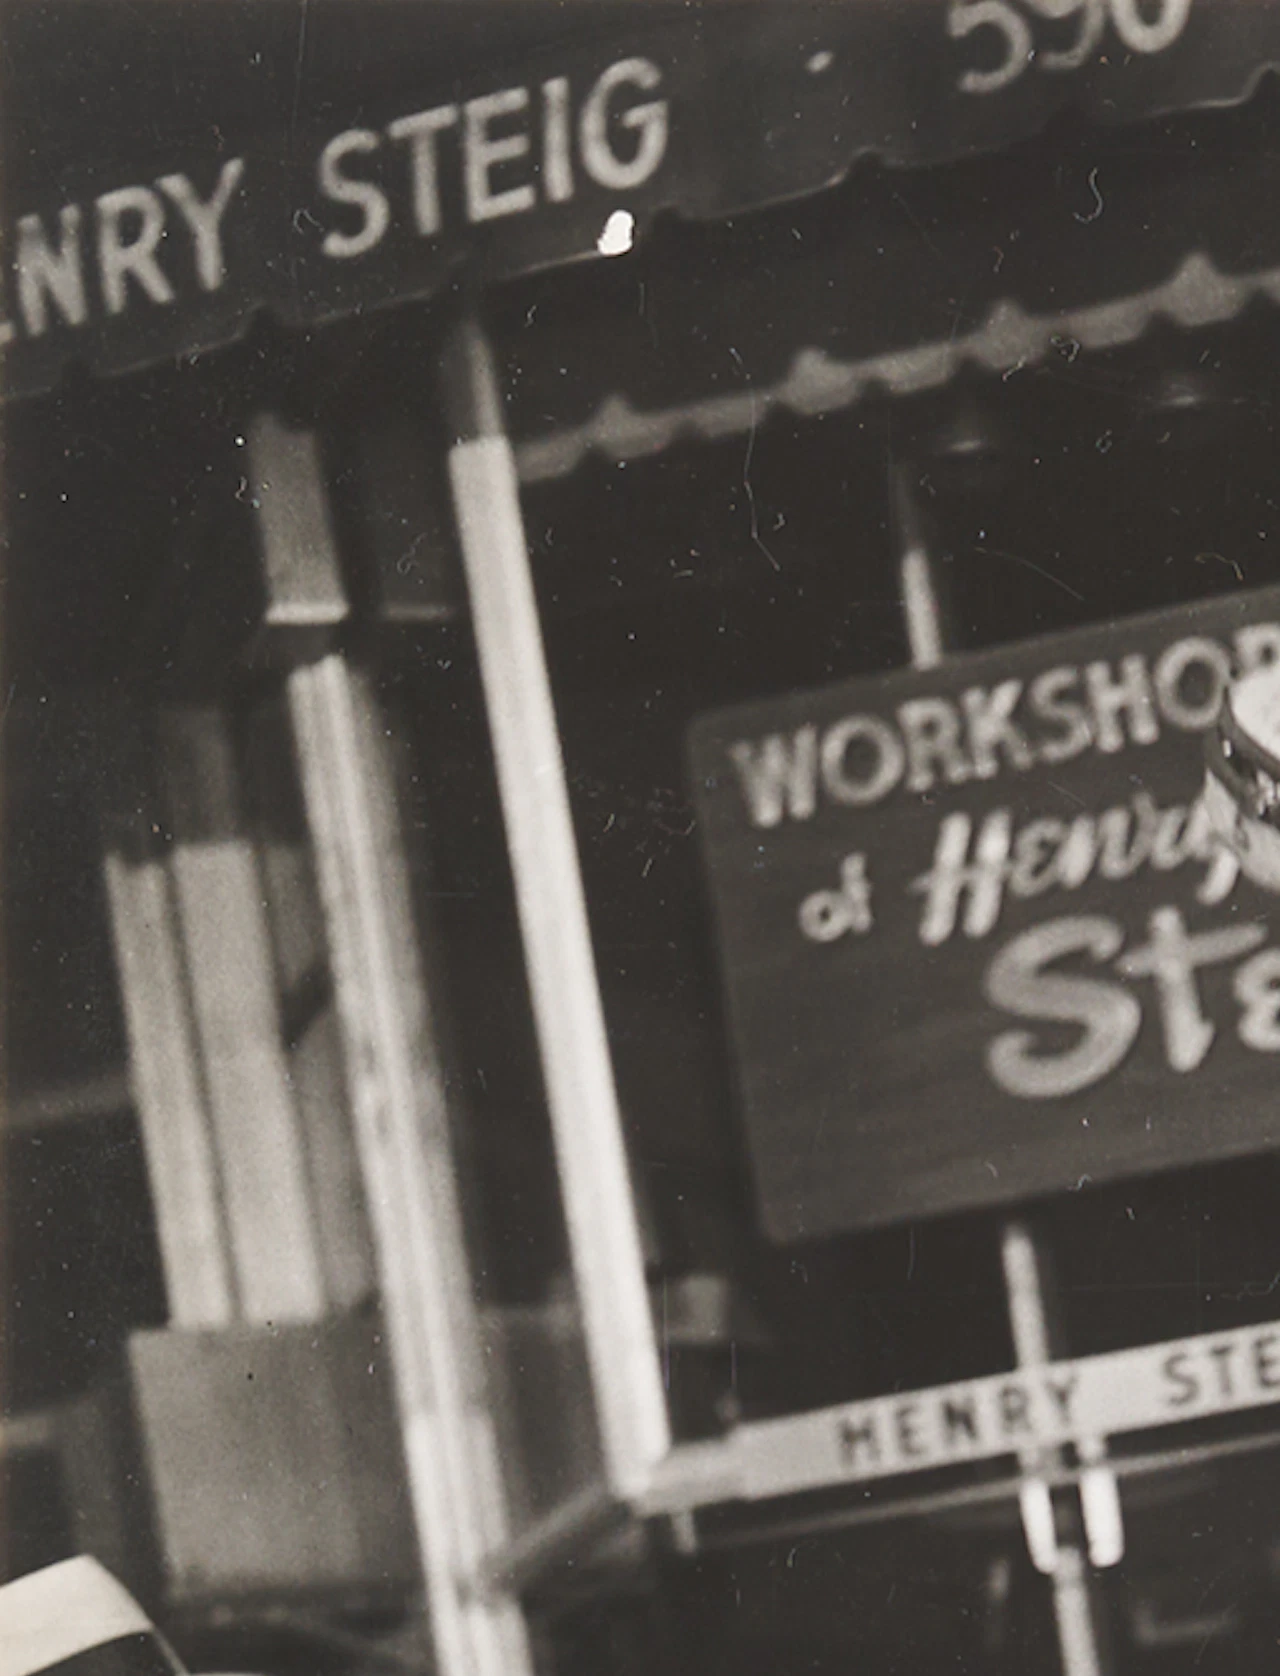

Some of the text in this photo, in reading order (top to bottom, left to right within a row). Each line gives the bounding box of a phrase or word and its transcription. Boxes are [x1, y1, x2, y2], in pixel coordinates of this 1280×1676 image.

[0, 57, 669, 345] NRY STEIG
[834, 1373, 1080, 1462] HENRY
